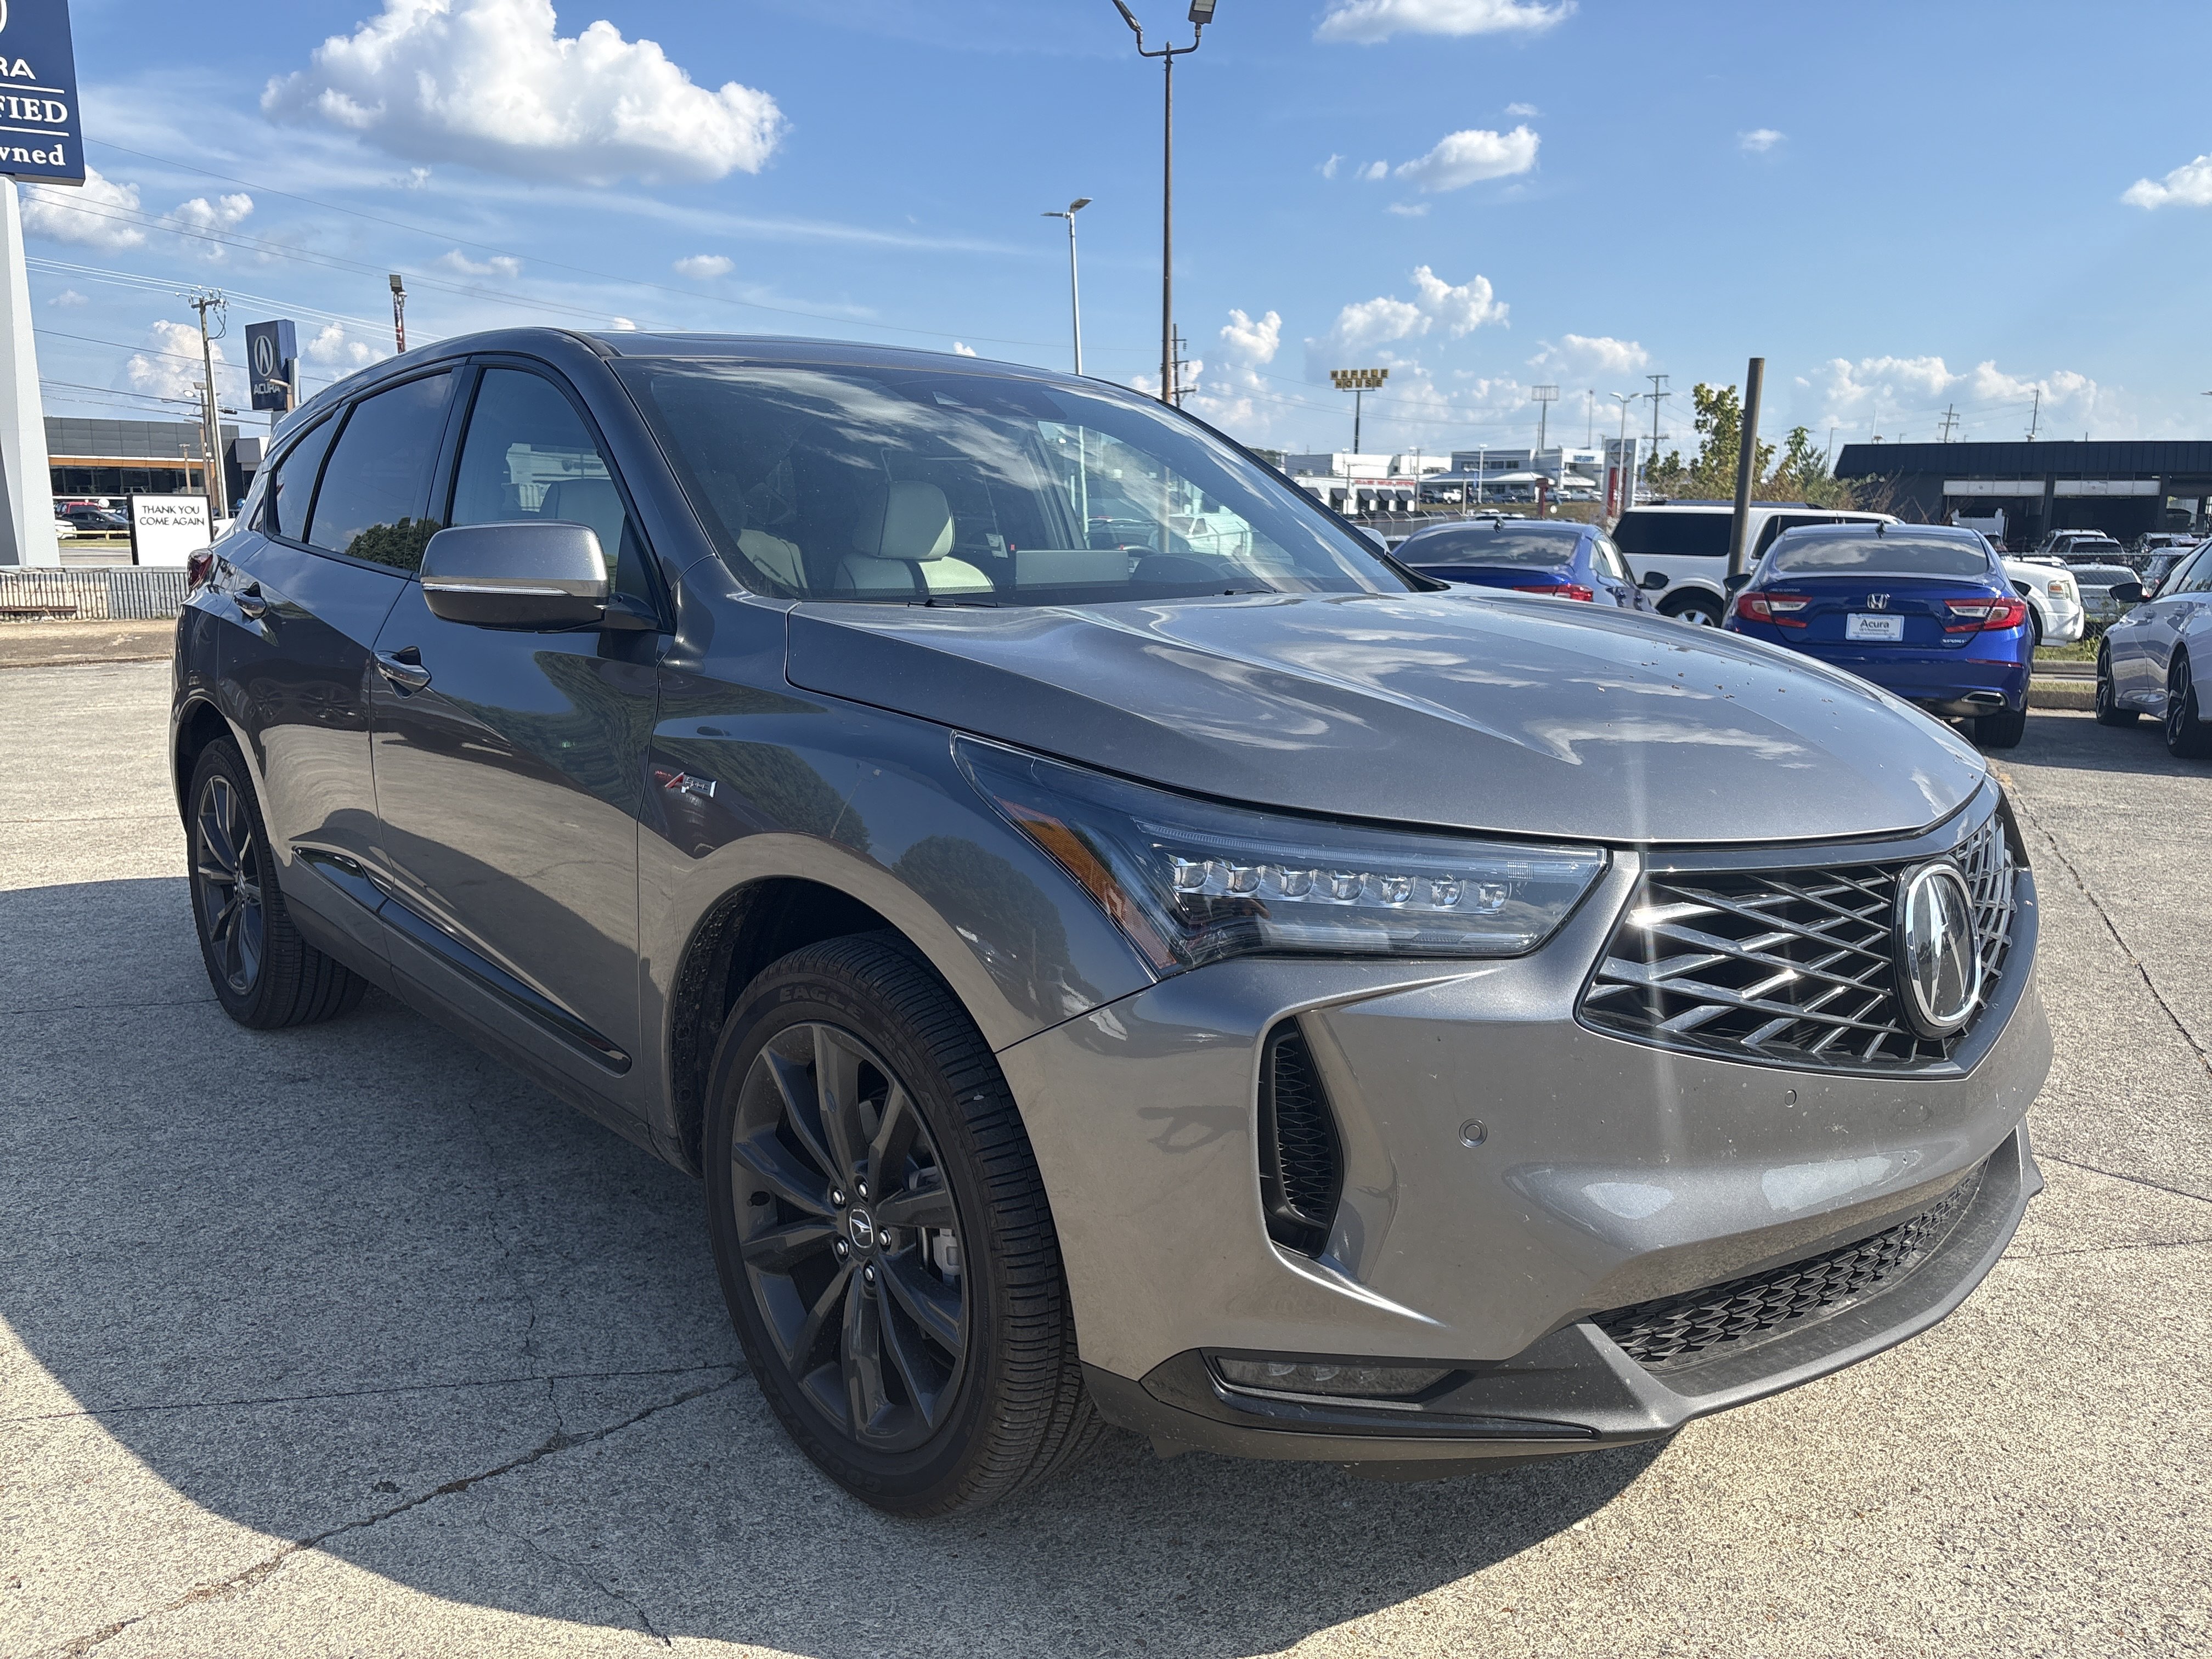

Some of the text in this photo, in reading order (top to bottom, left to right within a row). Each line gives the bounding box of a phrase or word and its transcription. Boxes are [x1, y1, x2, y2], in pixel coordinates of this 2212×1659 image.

[0, 95, 68, 123] IED
[253, 383, 281, 394] ACURA
[1335, 379, 1383, 388] HOUSE
[142, 505, 200, 514] THANK YOU
[139, 517, 205, 526] COME AGAIN
[1860, 619, 1889, 629] Acura
[780, 985, 865, 1020] EAGLE
